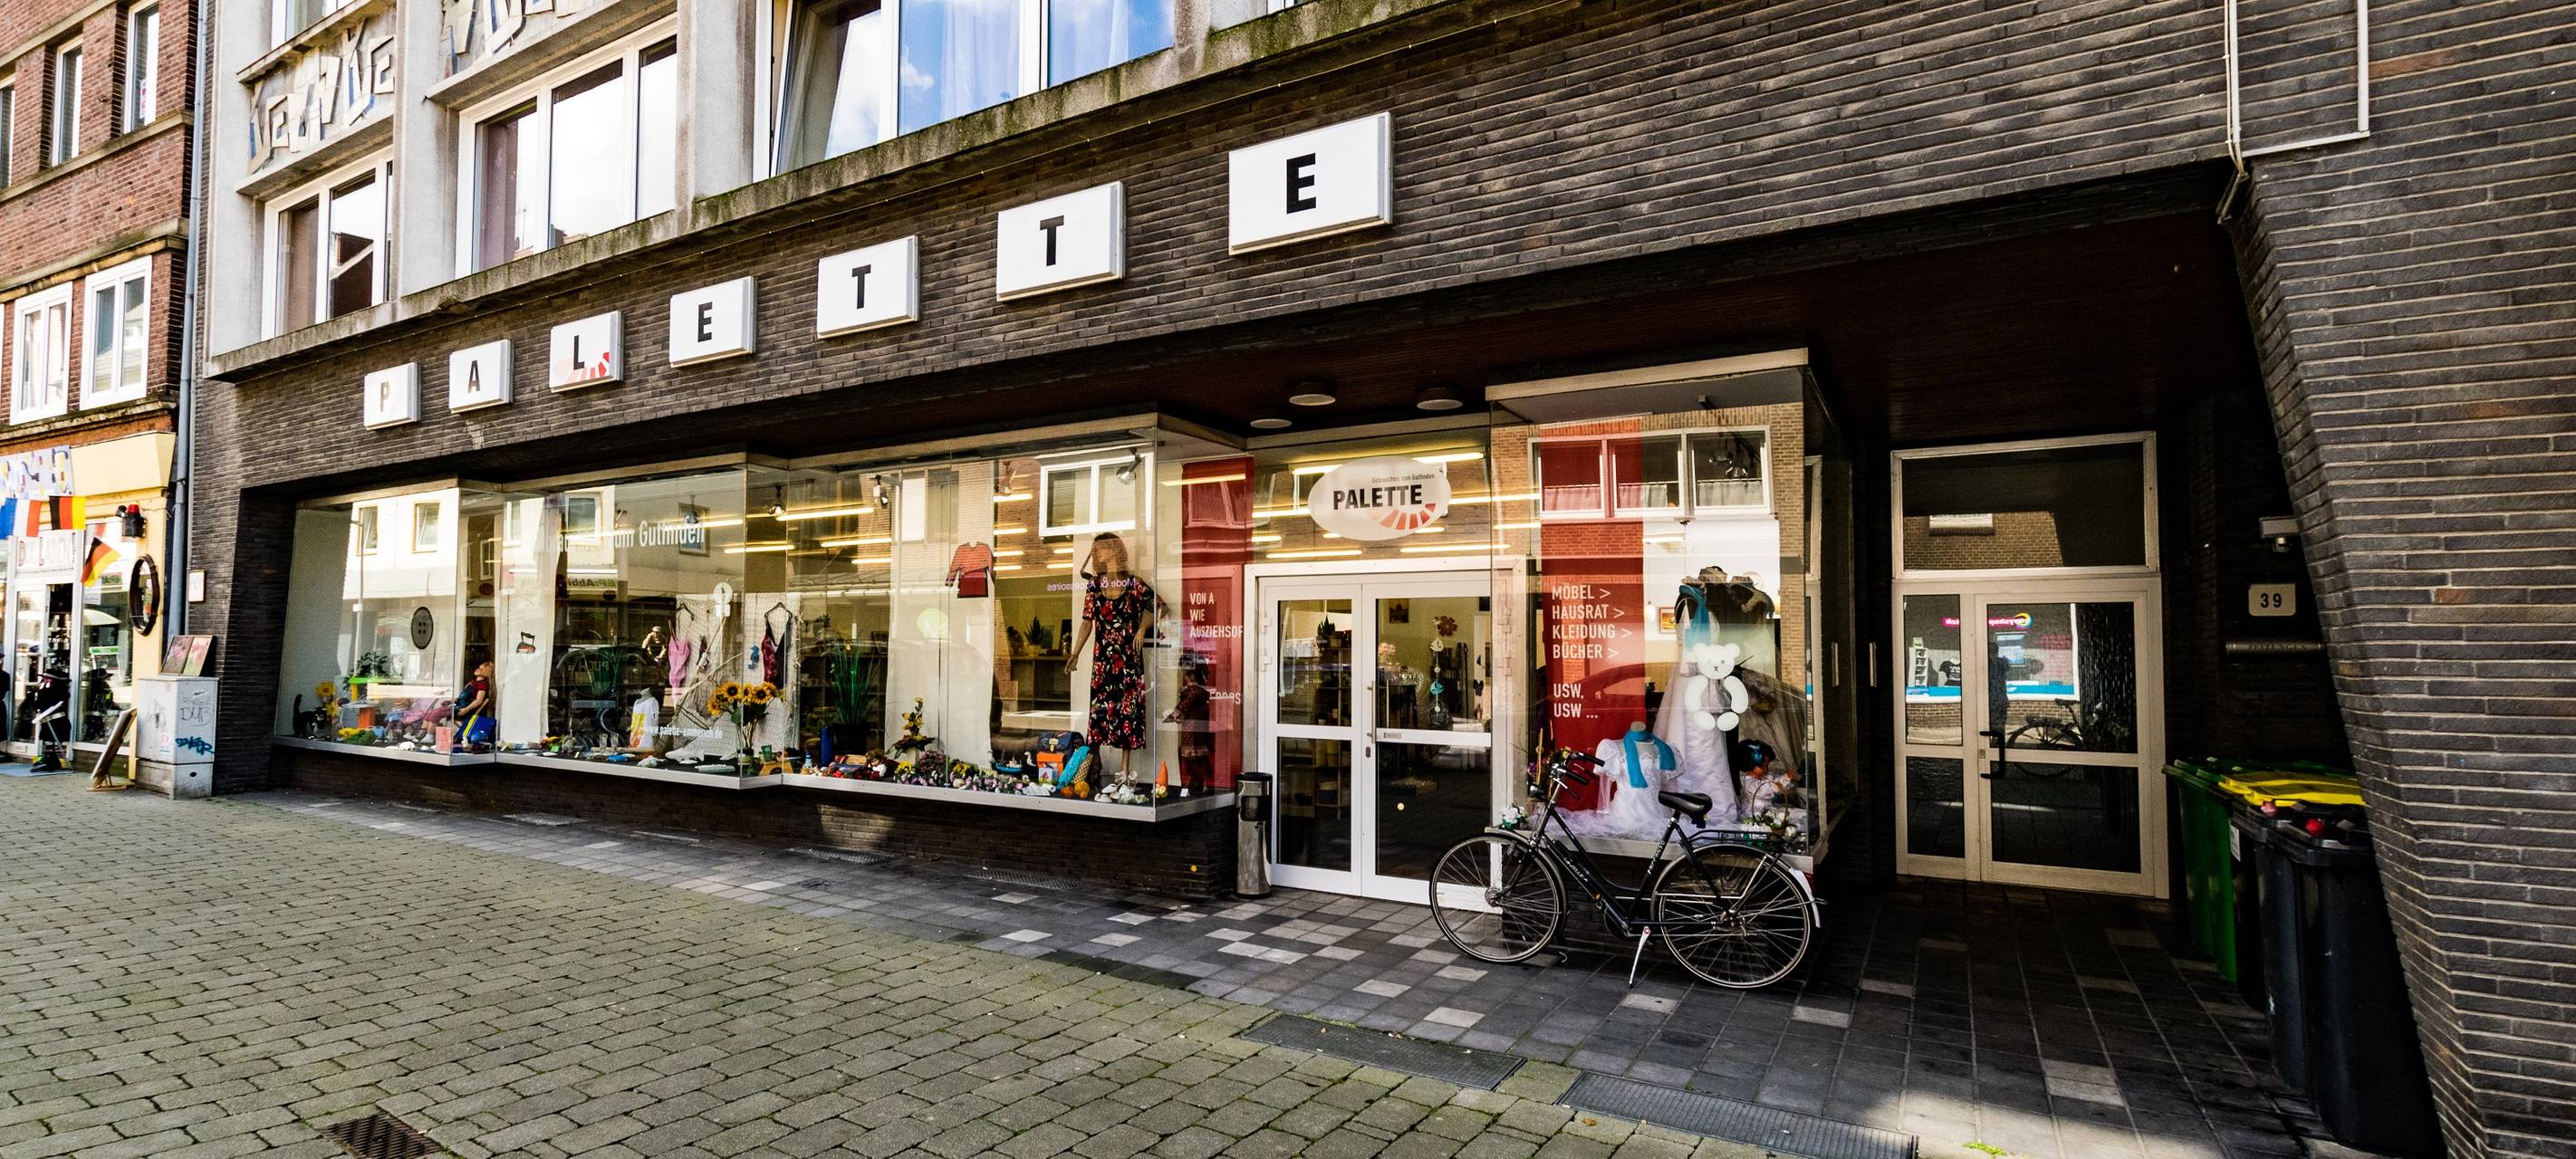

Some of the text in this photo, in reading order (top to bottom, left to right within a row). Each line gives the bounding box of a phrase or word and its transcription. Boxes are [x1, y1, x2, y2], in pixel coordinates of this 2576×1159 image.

[1333, 484, 1423, 511] PALETTE
[639, 517, 705, 548] Gutfinden
[1189, 592, 1215, 605] VON A
[1552, 583, 1595, 600] MÖBEL
[2260, 593, 2282, 608] 39
[1189, 608, 1205, 621] WIE
[1552, 604, 1610, 620] HAUSRAT
[1552, 624, 1616, 639] KLEIDUNG
[1552, 643, 1603, 659] BÜCHER
[1553, 703, 1581, 718] USW
